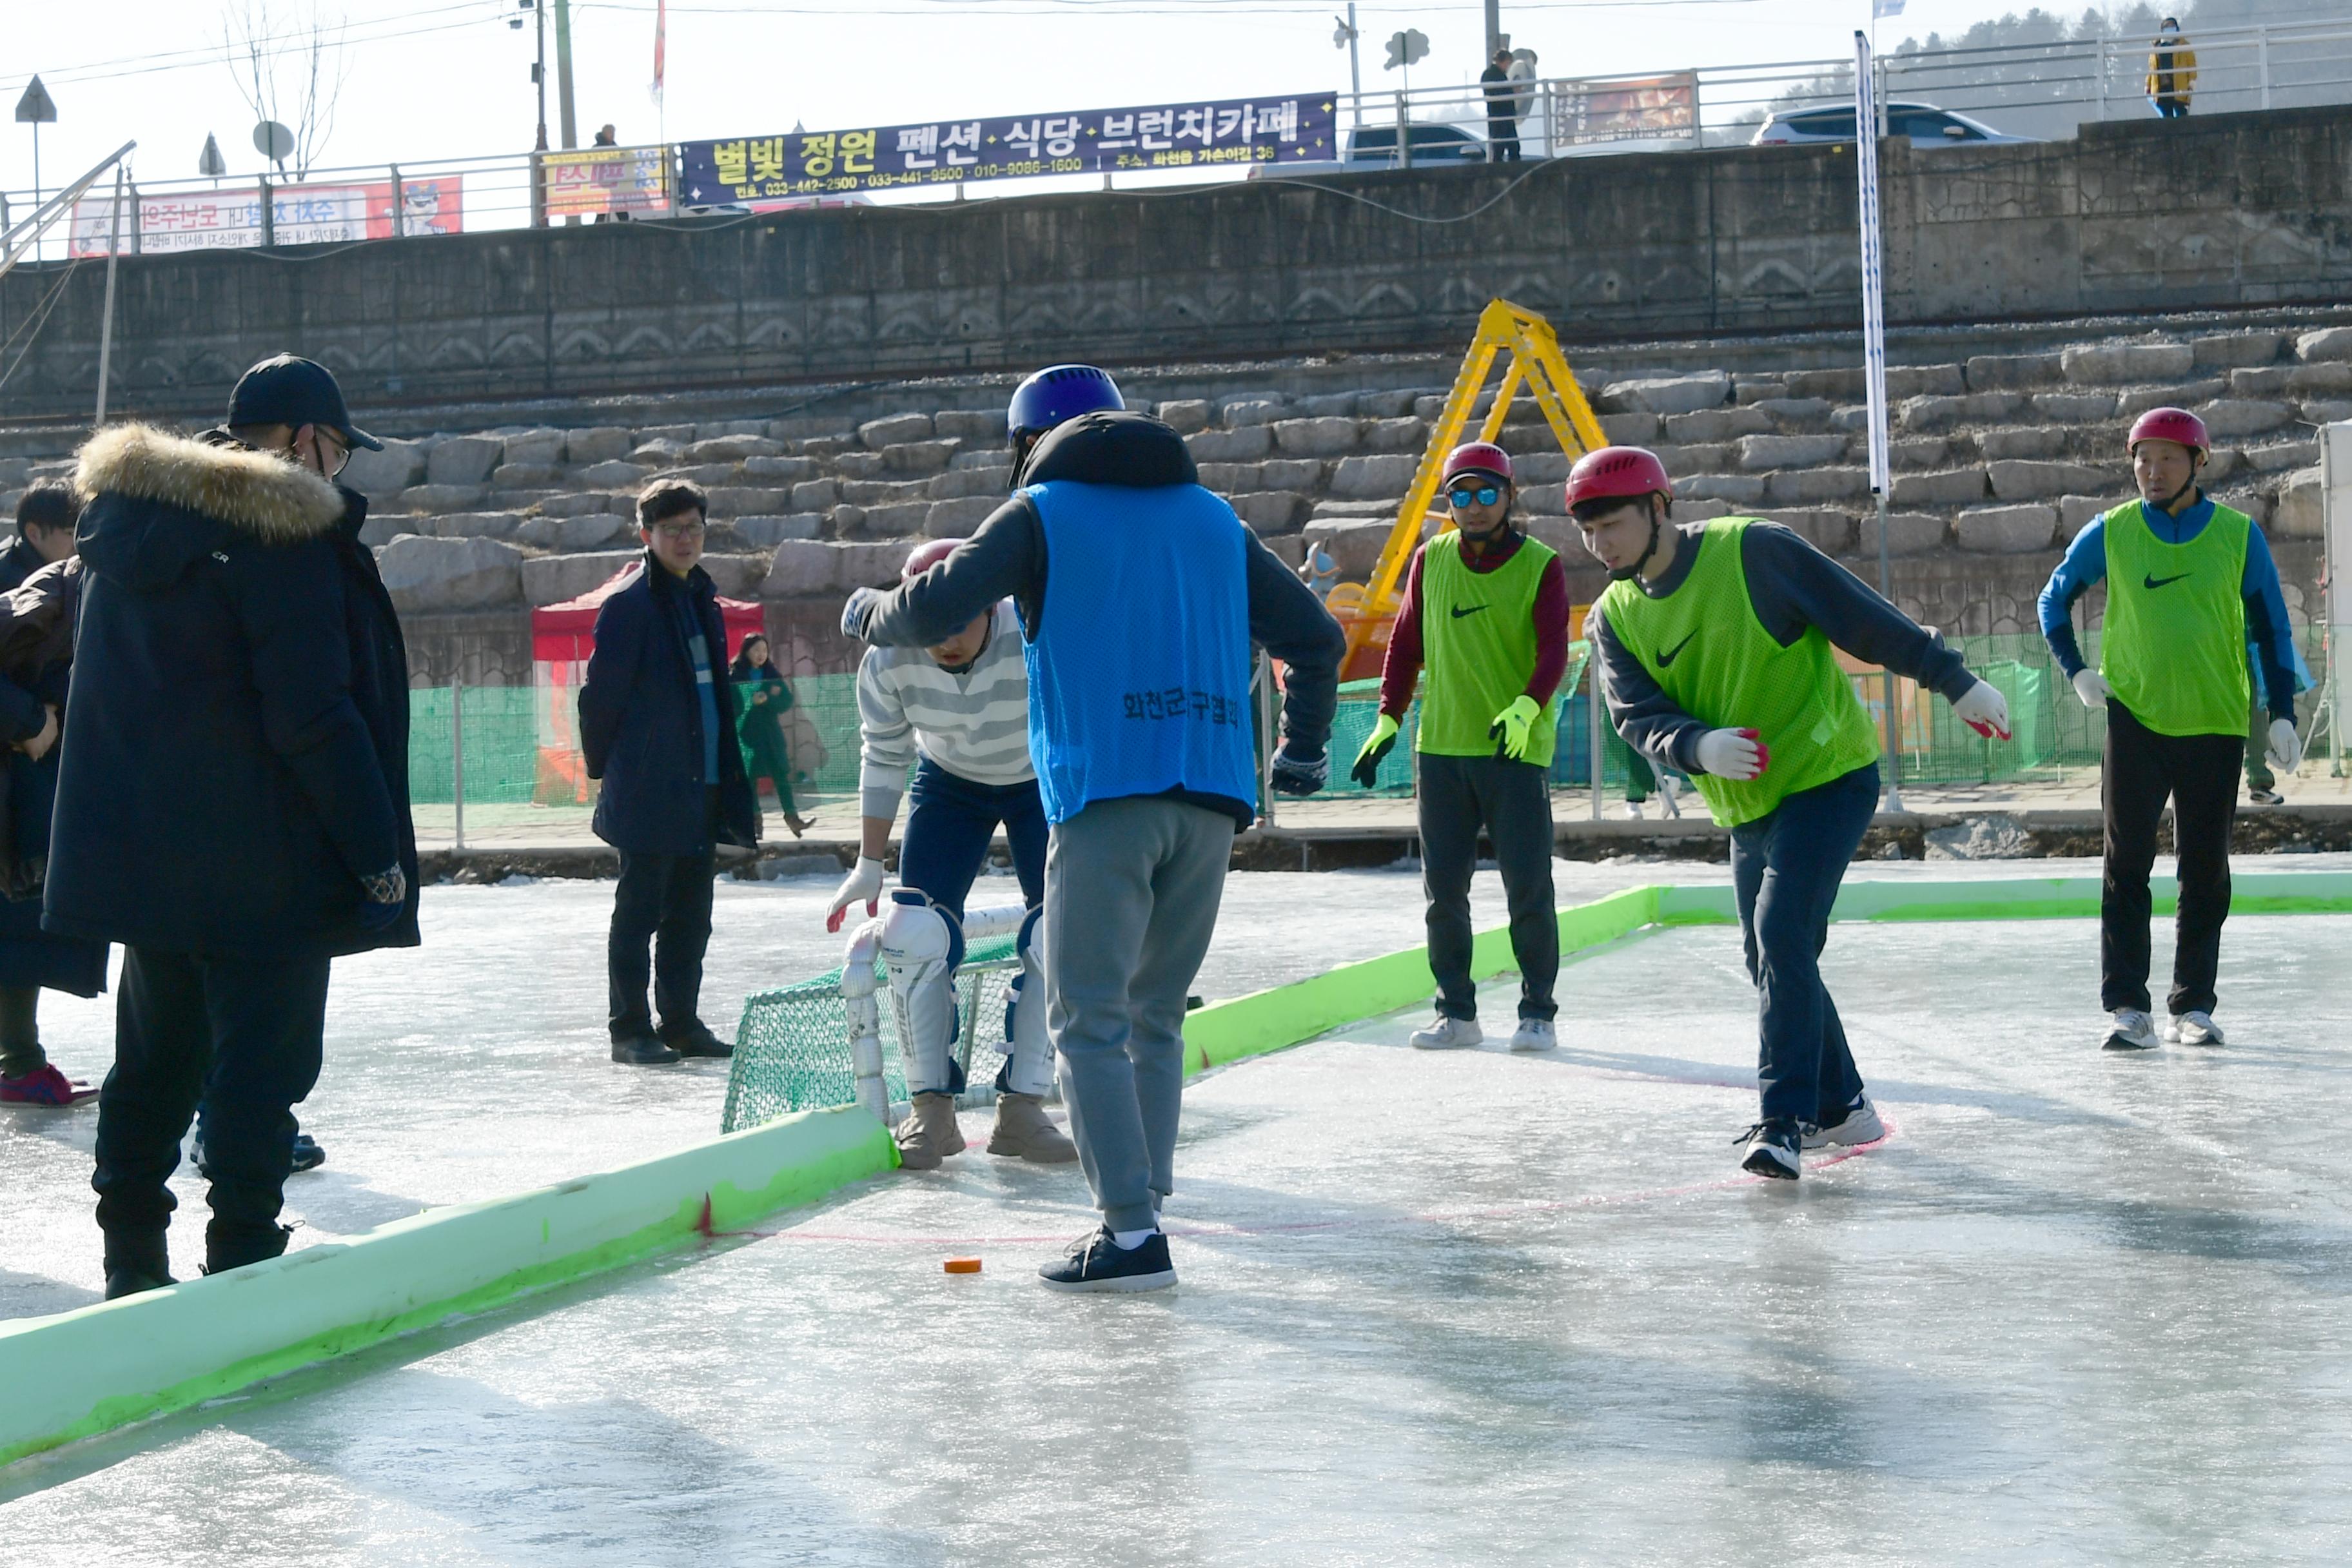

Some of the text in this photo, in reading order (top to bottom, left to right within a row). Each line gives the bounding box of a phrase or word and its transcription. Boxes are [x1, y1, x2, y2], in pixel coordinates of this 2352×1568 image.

[714, 100, 1298, 185] 별빛 정원 펜션 식당 브런치카페
[765, 177, 858, 197] 033-442-2500
[867, 166, 964, 187] 033-441-9500
[974, 157, 1083, 177] 010-9086-1600
[1153, 150, 1193, 166] 화천읍
[1255, 146, 1275, 161] 36
